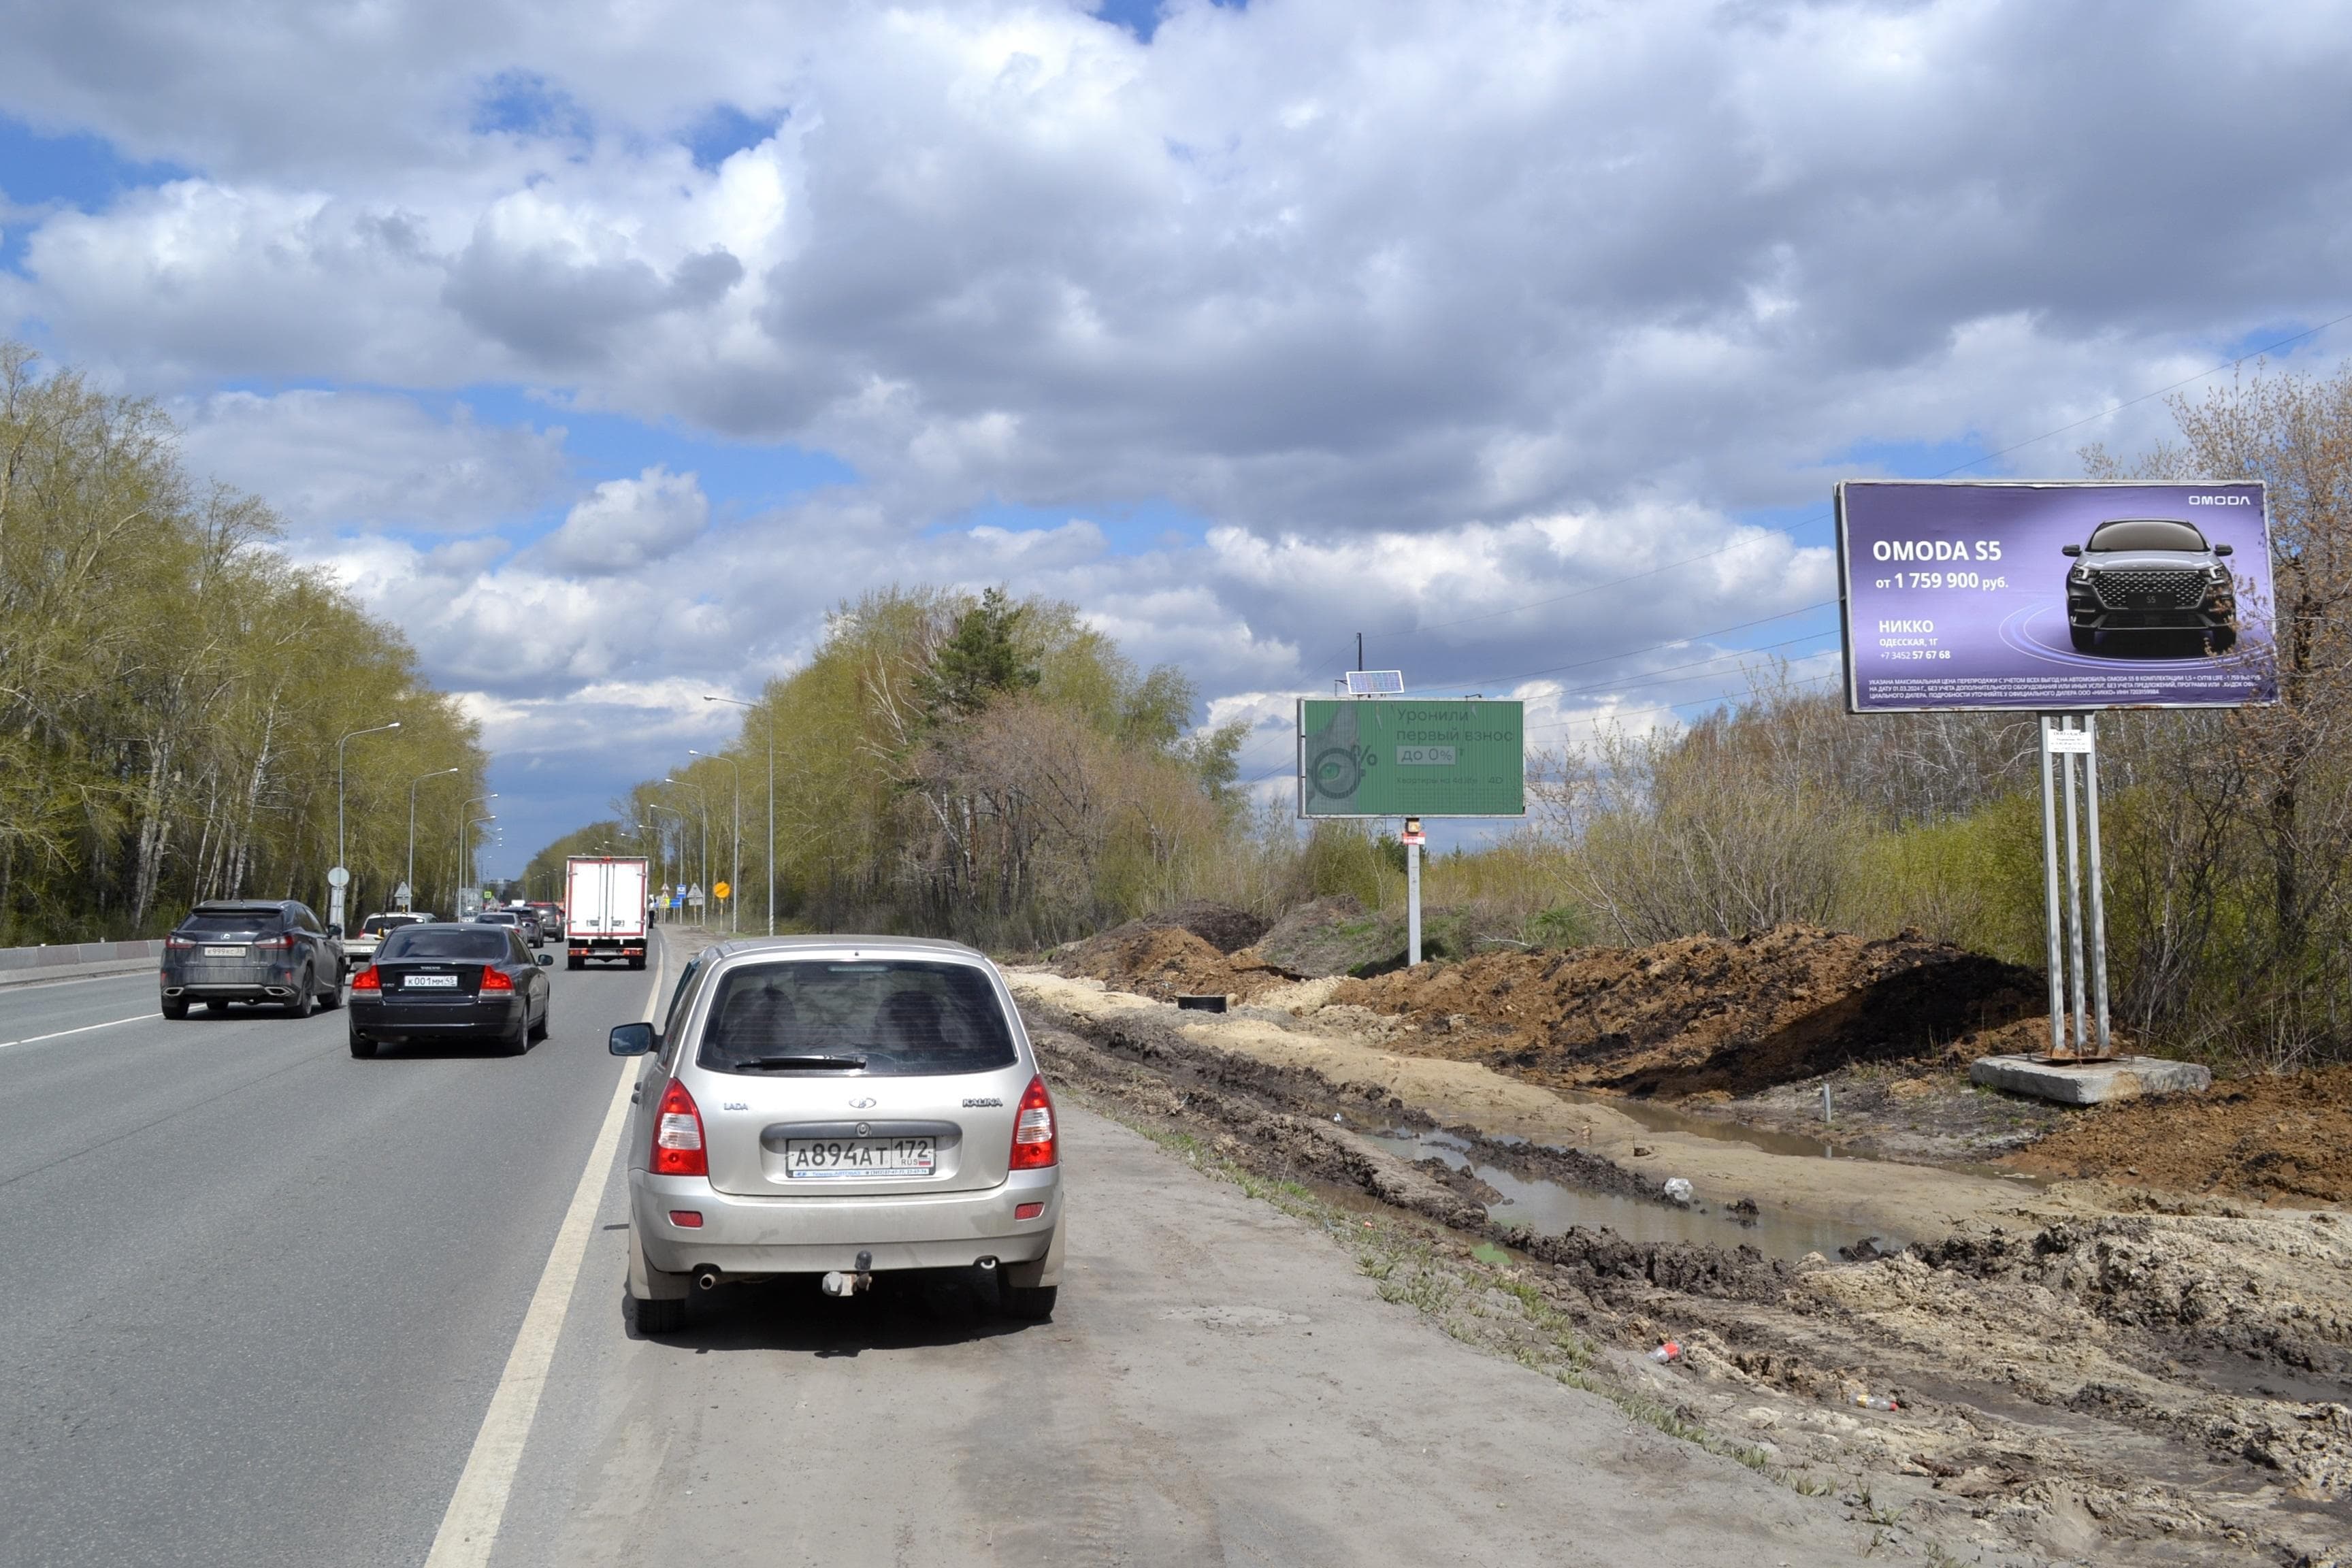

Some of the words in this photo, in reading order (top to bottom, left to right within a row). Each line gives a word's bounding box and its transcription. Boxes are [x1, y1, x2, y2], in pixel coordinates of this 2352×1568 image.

[2189, 495, 2251, 505] OMODA
[1873, 540, 1970, 561] OMODA
[1975, 540, 2002, 561] S5
[1876, 579, 1891, 589] от
[1895, 572, 1904, 589] 1
[1909, 572, 1942, 589] 759
[1946, 572, 1978, 589] 900
[1982, 576, 2008, 591] руб.
[1879, 620, 1933, 633] НИККО
[1880, 638, 1927, 647] ОДЕССКАЯ,
[1891, 651, 1911, 659] 3452
[1912, 651, 1923, 659] 57
[1925, 651, 1936, 659] 67
[1939, 651, 1950, 659] 68
[1398, 708, 1469, 724] Уронили
[1396, 727, 1459, 745] первый
[1465, 730, 1514, 742] взнос
[1401, 750, 1422, 762] до
[1428, 748, 1453, 761] 0%
[724, 1102, 749, 1111] LADA
[962, 1098, 1003, 1107] KALINA
[894, 1140, 928, 1158] 172
